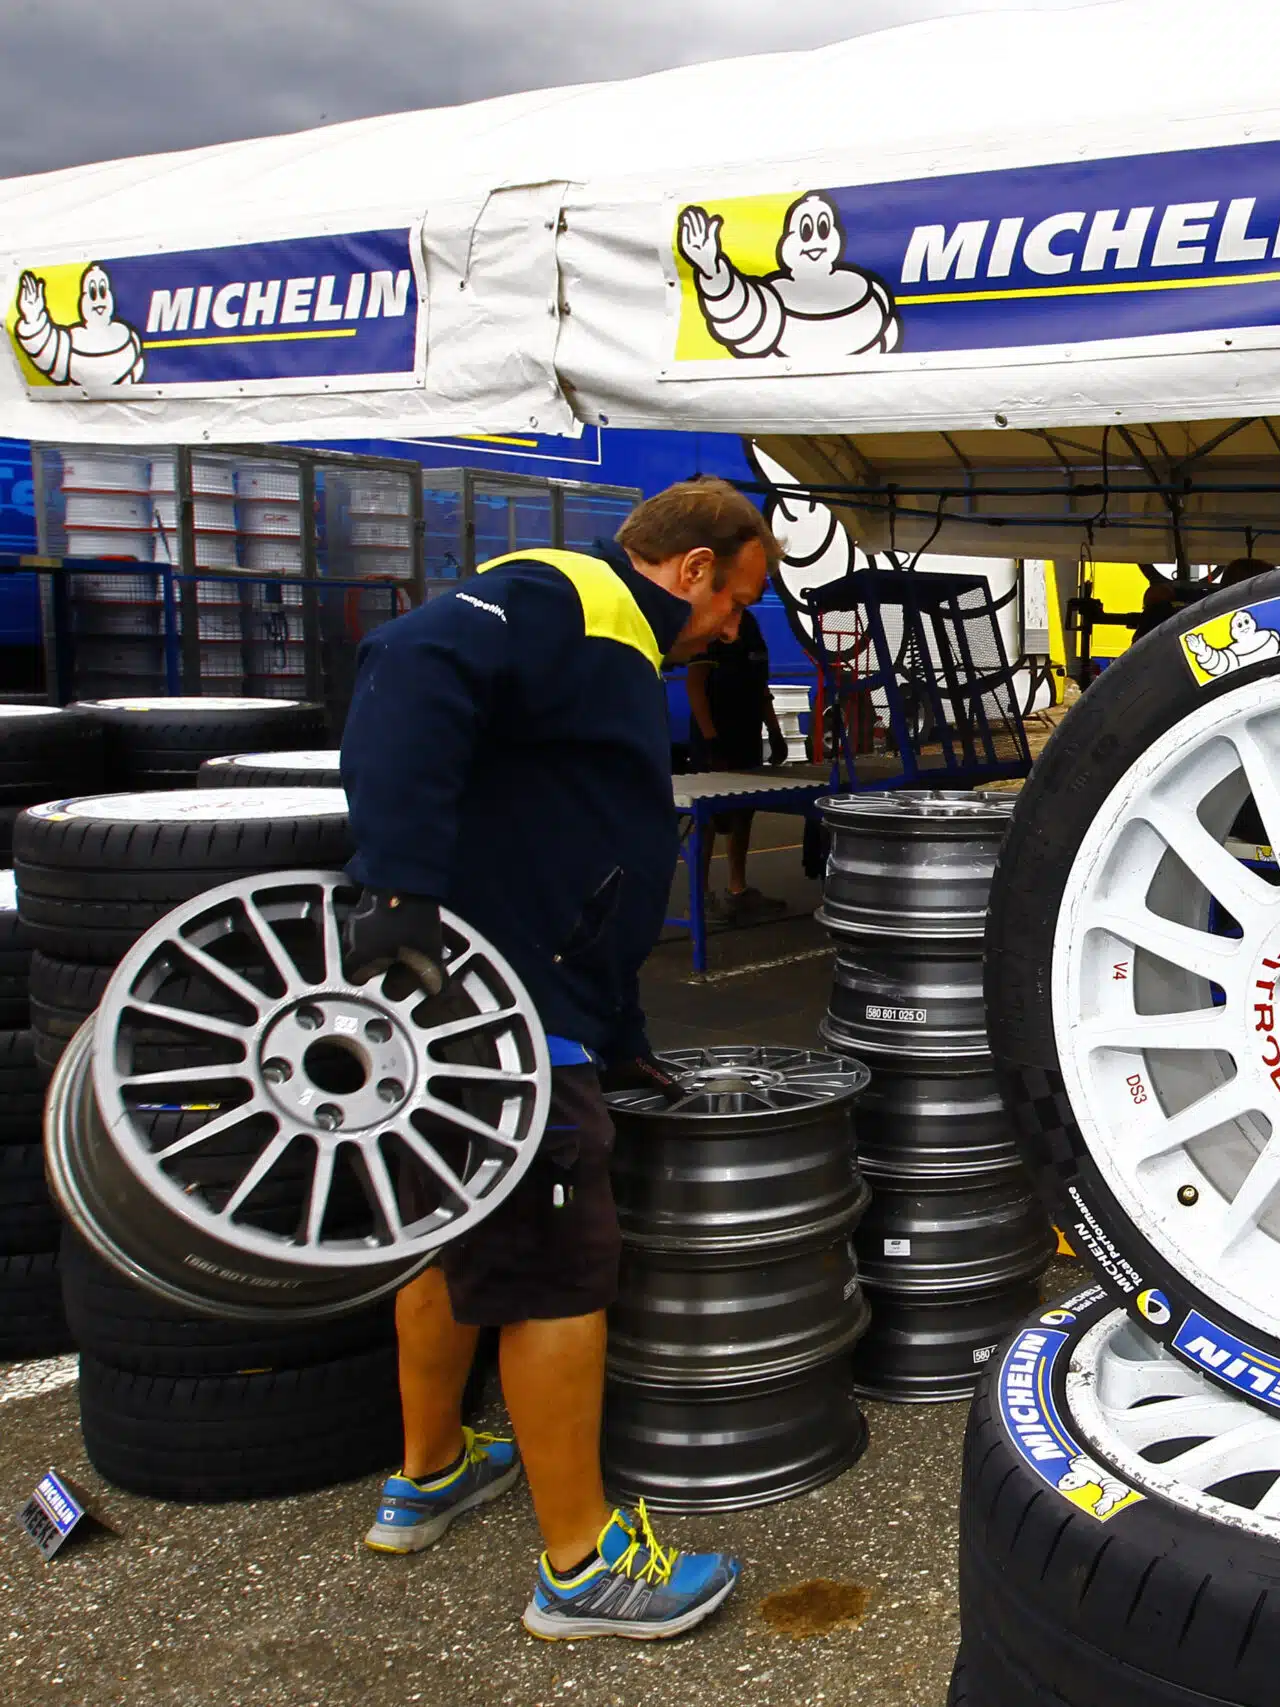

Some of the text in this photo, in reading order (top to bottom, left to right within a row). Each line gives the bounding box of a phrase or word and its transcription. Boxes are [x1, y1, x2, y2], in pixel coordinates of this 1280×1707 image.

[146, 270, 410, 333] MICHELIN
[1112, 962, 1128, 980] V4
[868, 1008, 881, 1018] 580
[882, 1009, 896, 1019] 601
[898, 1010, 914, 1020] 025
[1126, 1073, 1147, 1104] DS3
[1068, 1186, 1143, 1287] Total Performance
[1074, 1222, 1135, 1293] MICHELIN
[975, 1349, 990, 1361] 580
[1006, 1333, 1067, 1461] MICHELIN
[37, 1478, 76, 1526] MICHELIN
